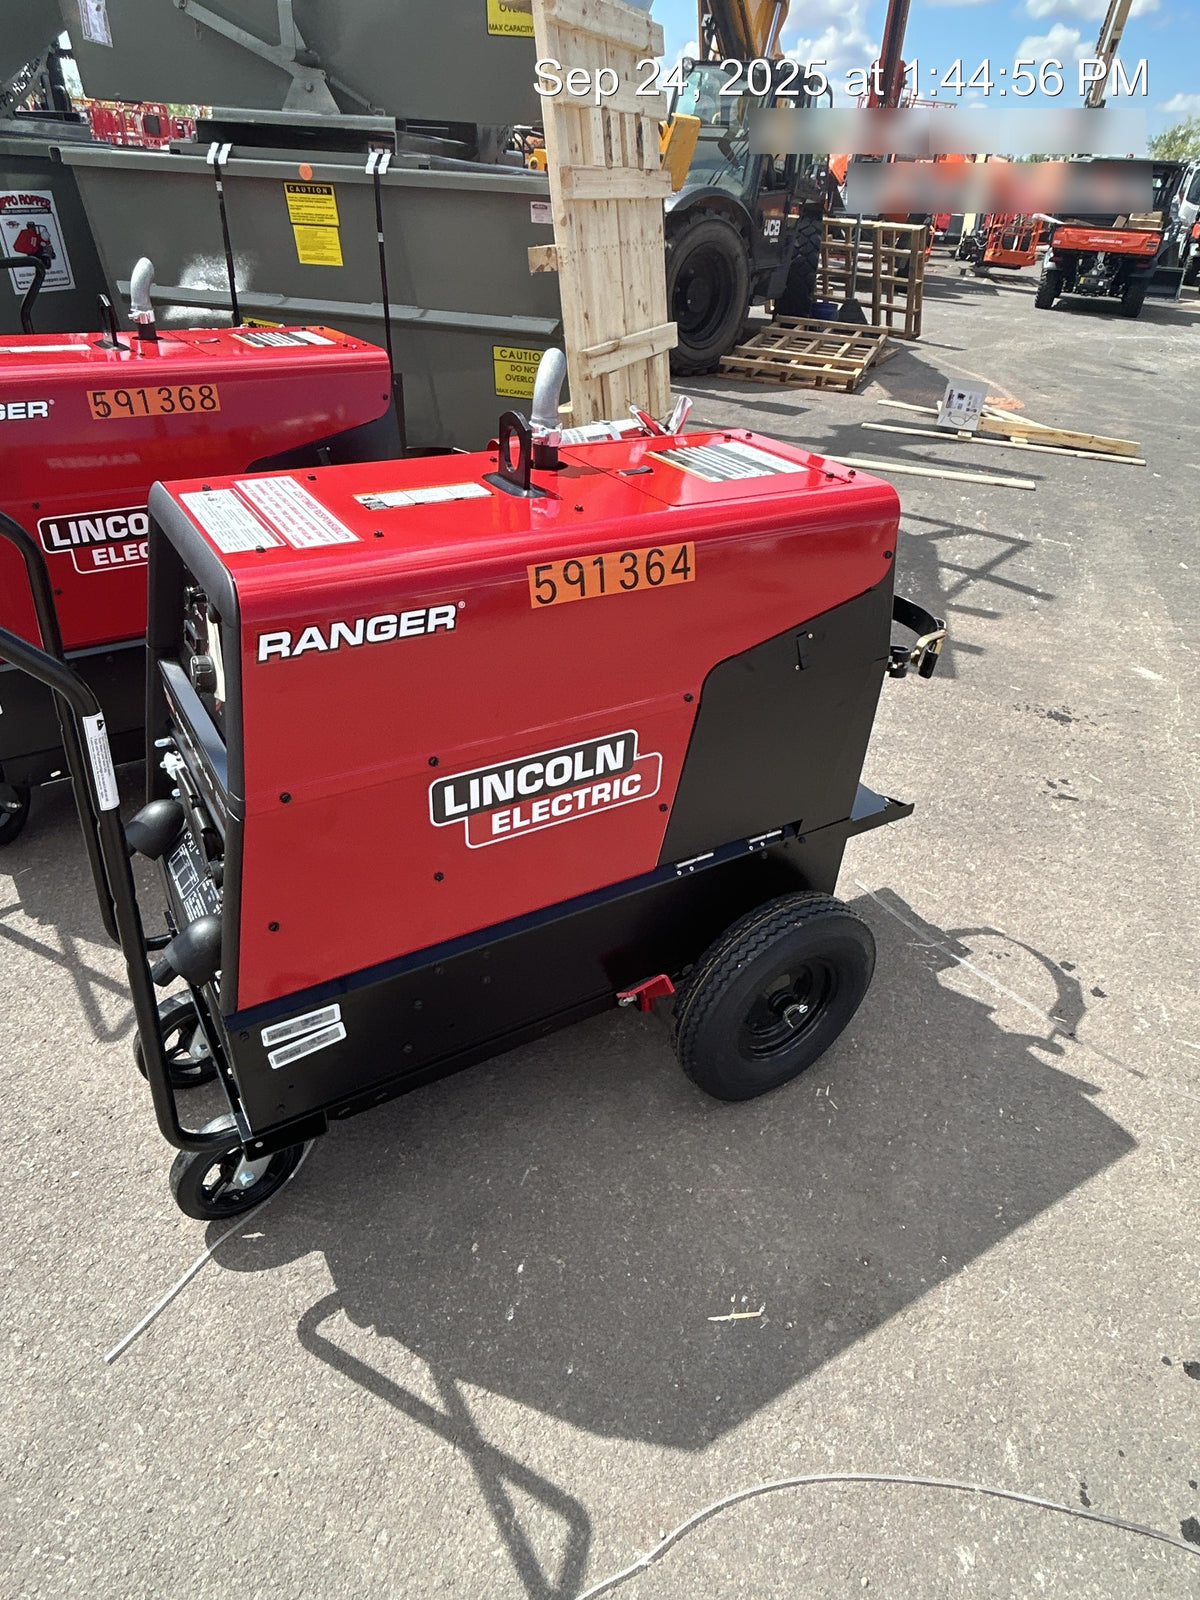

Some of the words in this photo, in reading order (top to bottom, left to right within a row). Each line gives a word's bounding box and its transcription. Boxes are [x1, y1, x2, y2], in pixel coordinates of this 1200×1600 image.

[289, 186, 328, 194] CAUTION
[18, 194, 52, 209] HOPPER
[764, 219, 780, 236] JCB
[500, 349, 542, 361] CAUTIO
[510, 364, 522, 372] DO
[524, 366, 538, 374] NO
[505, 374, 535, 384] OVERLO
[92, 385, 217, 418] 591368
[534, 544, 691, 604] 591364
[257, 604, 457, 662] RANGER
[444, 739, 625, 817] LINCOLN
[491, 773, 642, 836] ELECTRIC
